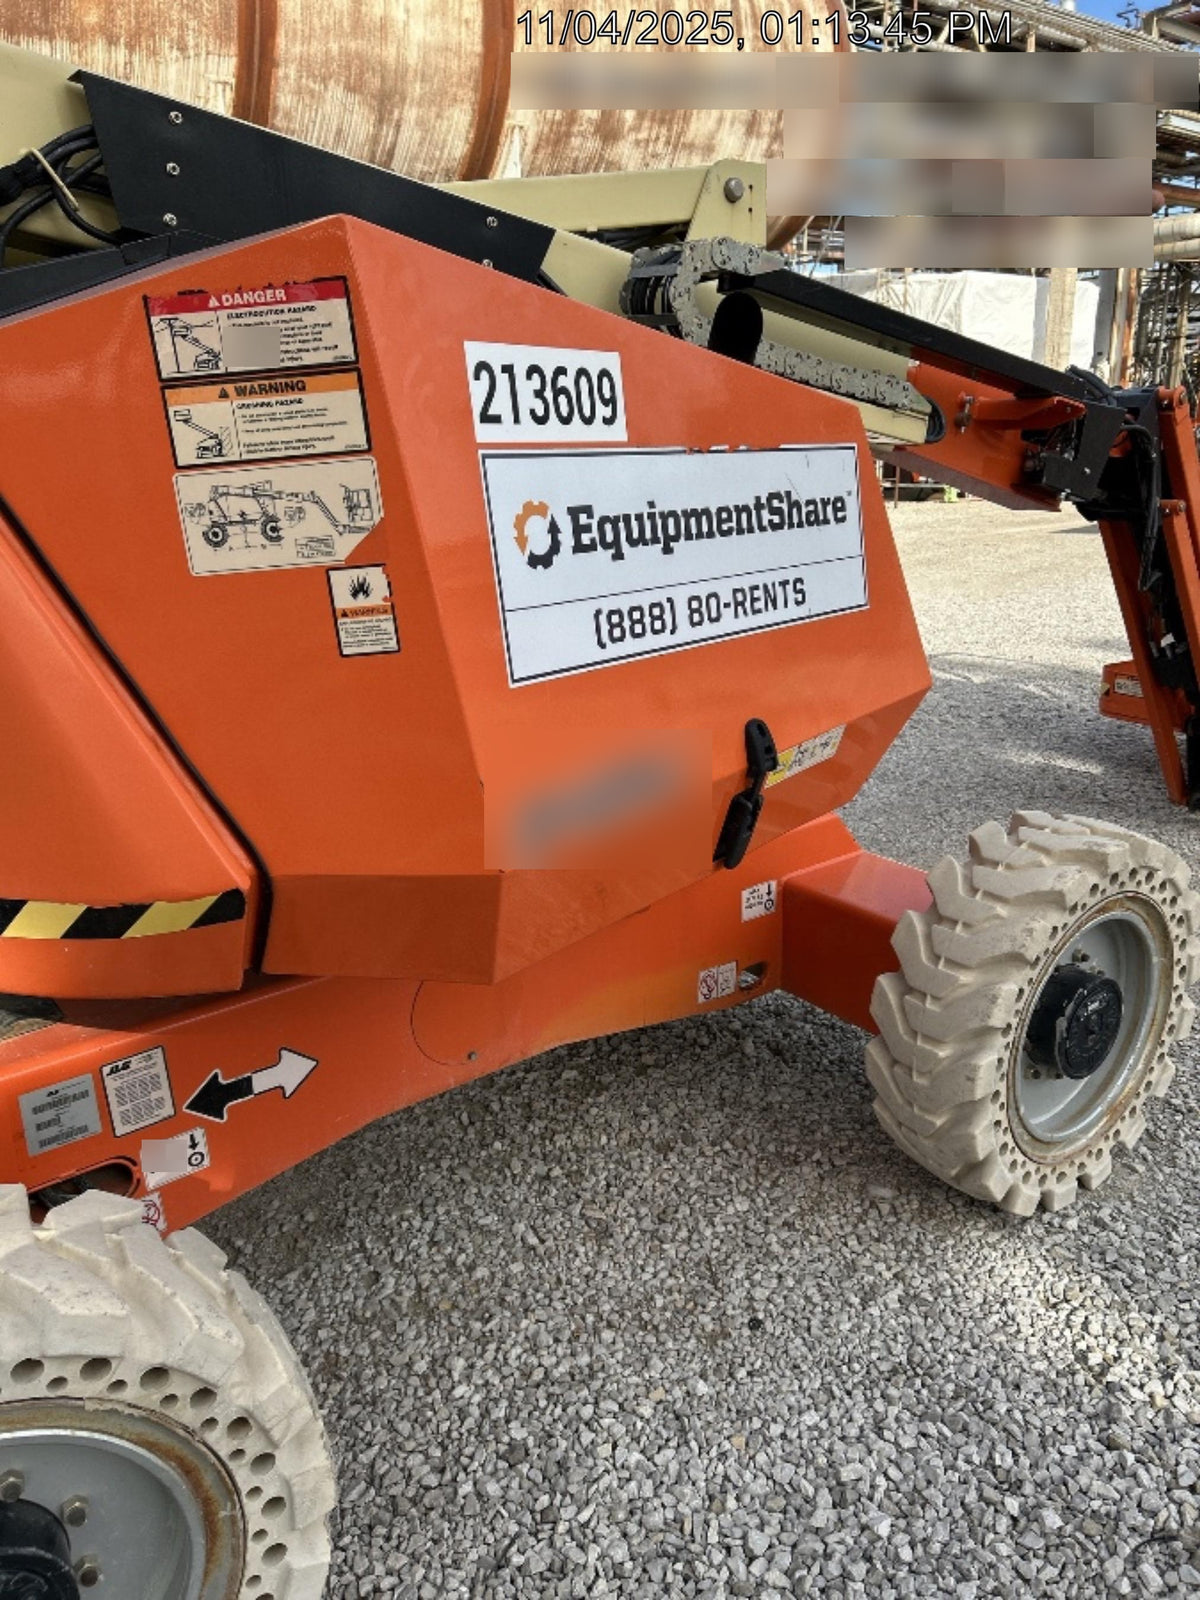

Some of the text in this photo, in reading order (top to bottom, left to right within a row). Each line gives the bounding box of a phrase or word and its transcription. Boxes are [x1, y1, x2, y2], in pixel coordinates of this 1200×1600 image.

[222, 289, 287, 306] DANGER
[234, 380, 306, 397] WARNING
[473, 360, 618, 426] 213609
[567, 491, 847, 561] EquipmentShare
[593, 577, 807, 649] (888) 80-RENTS
